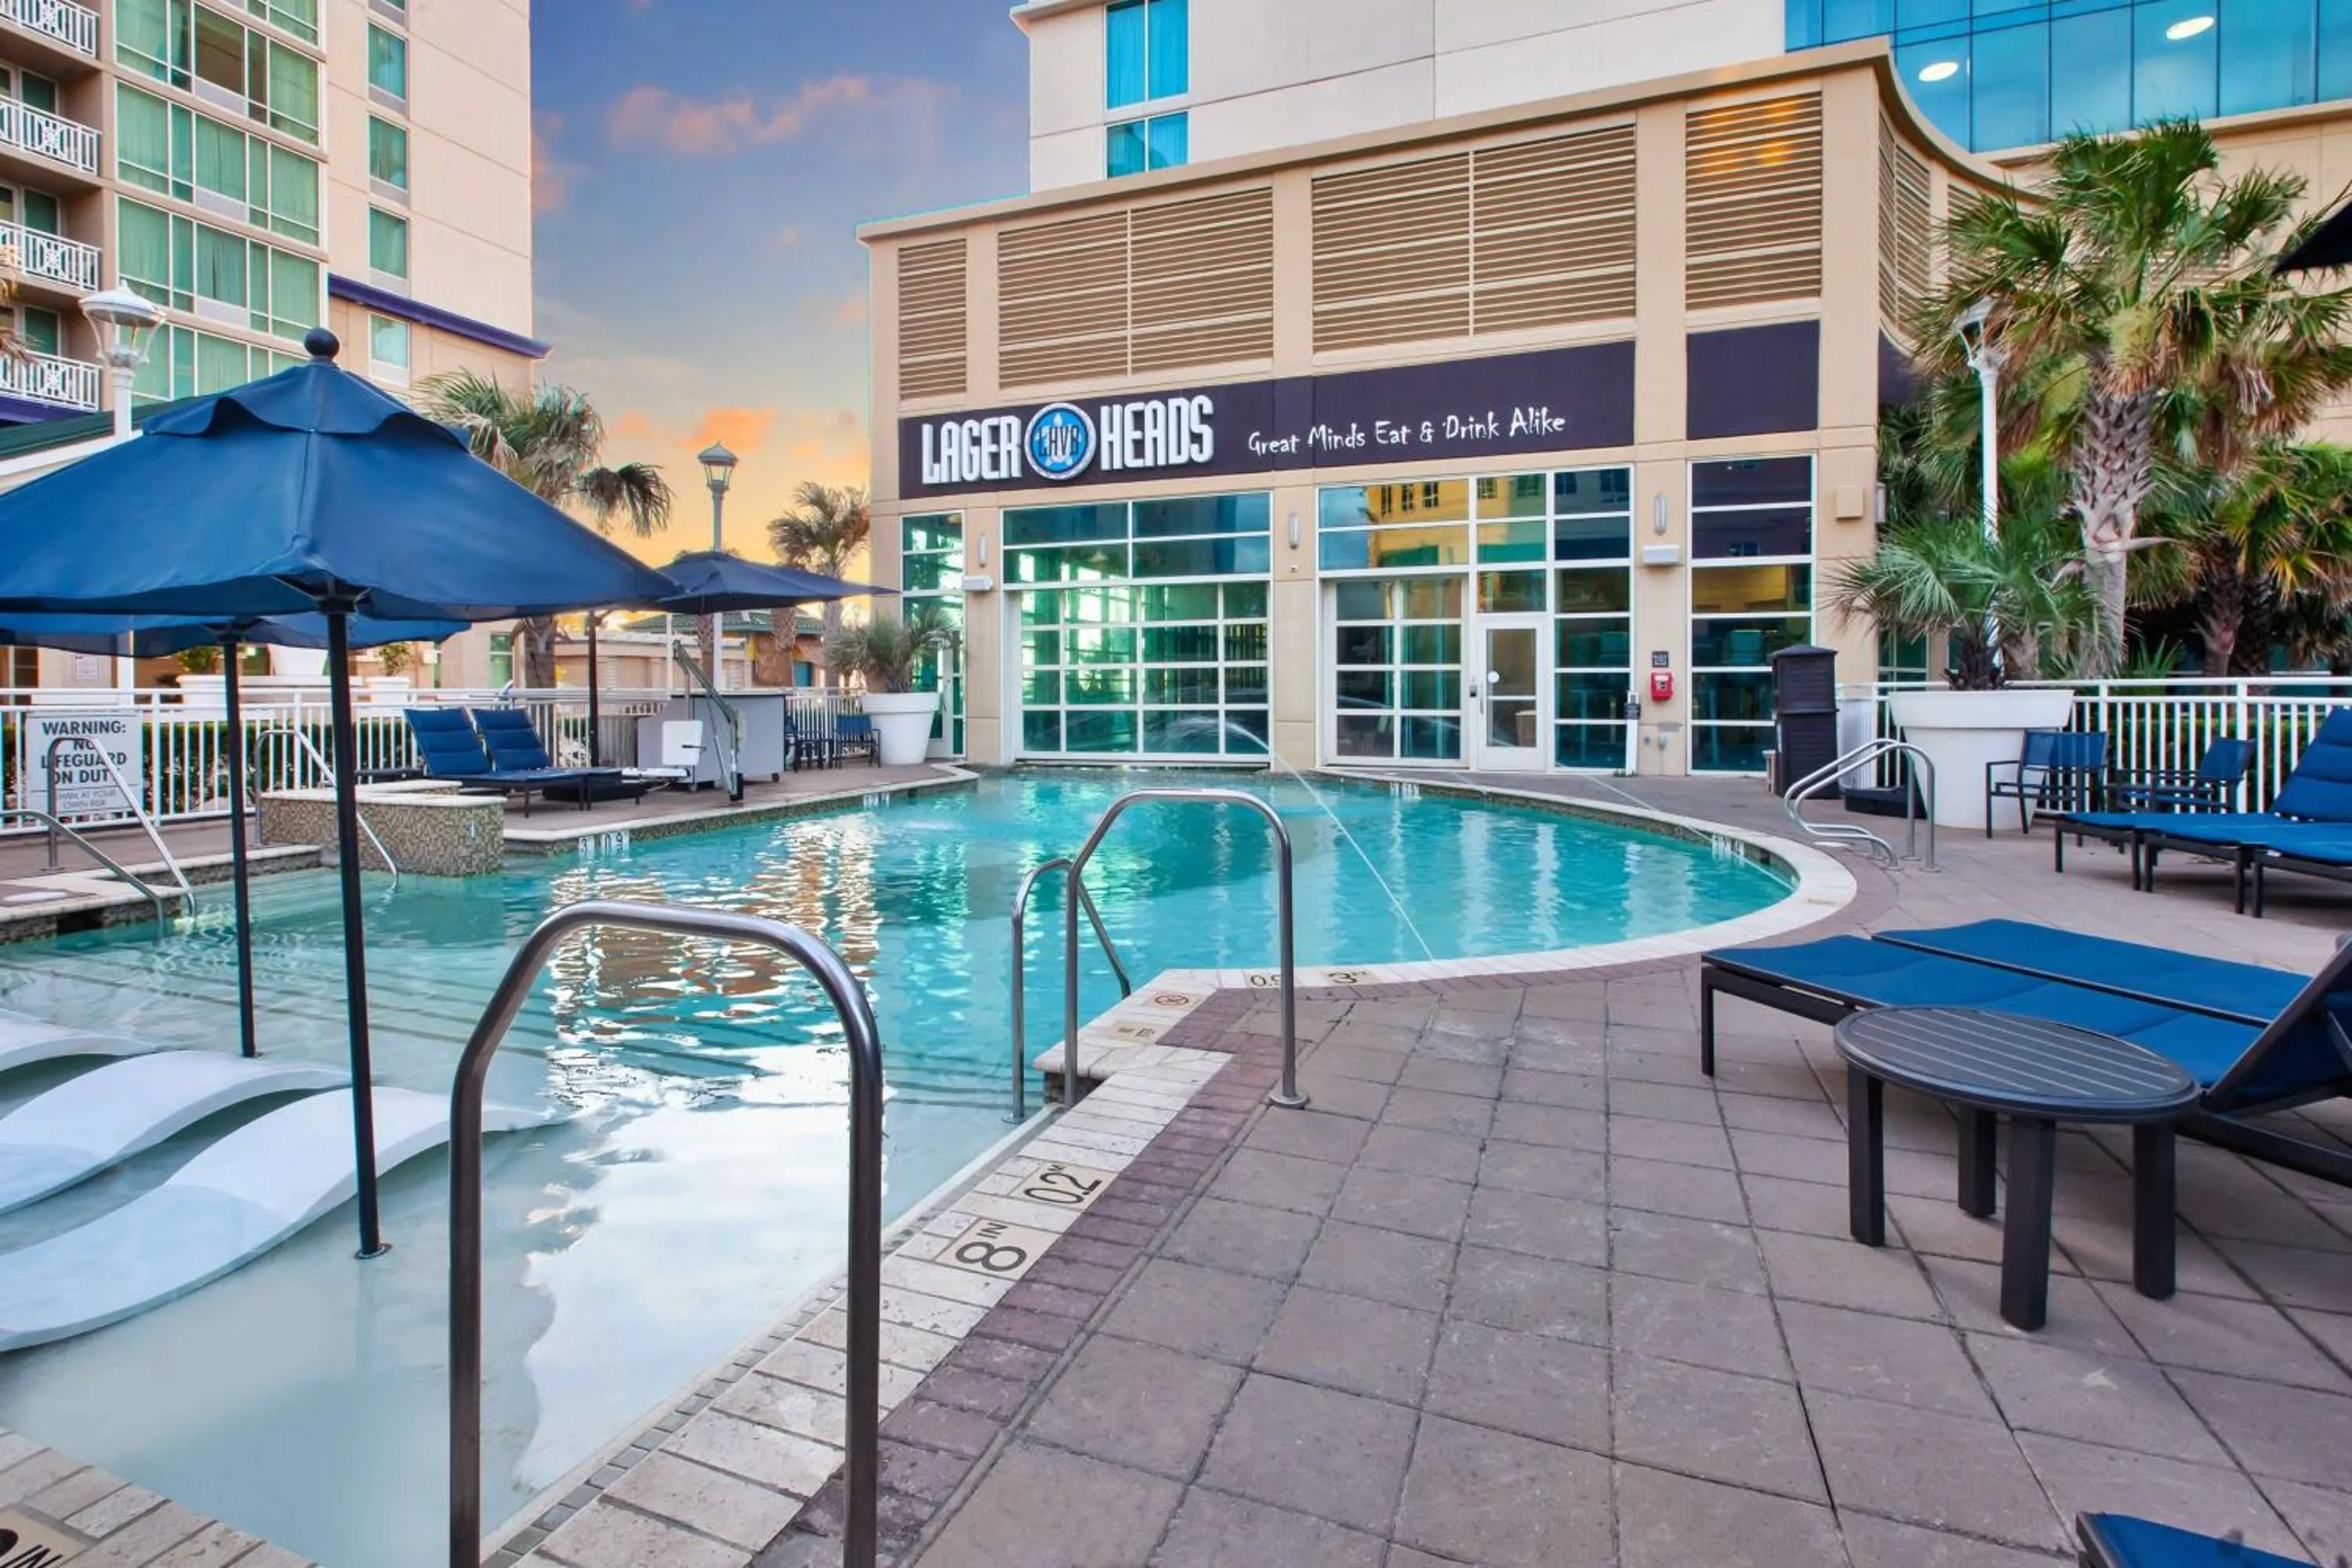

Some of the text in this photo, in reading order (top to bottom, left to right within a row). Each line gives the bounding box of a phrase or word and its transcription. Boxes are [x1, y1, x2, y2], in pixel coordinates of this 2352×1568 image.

[921, 394, 1215, 485] LAGER HEADS
[1248, 406, 1566, 456] Great Minds Eat & Drink Alike
[42, 720, 126, 735] WARNING:
[41, 752, 127, 769] LFEGUARD
[1328, 971, 1358, 985] 3
[1024, 1172, 1102, 1203] 0.2
[955, 1222, 1027, 1272] 8 IN
